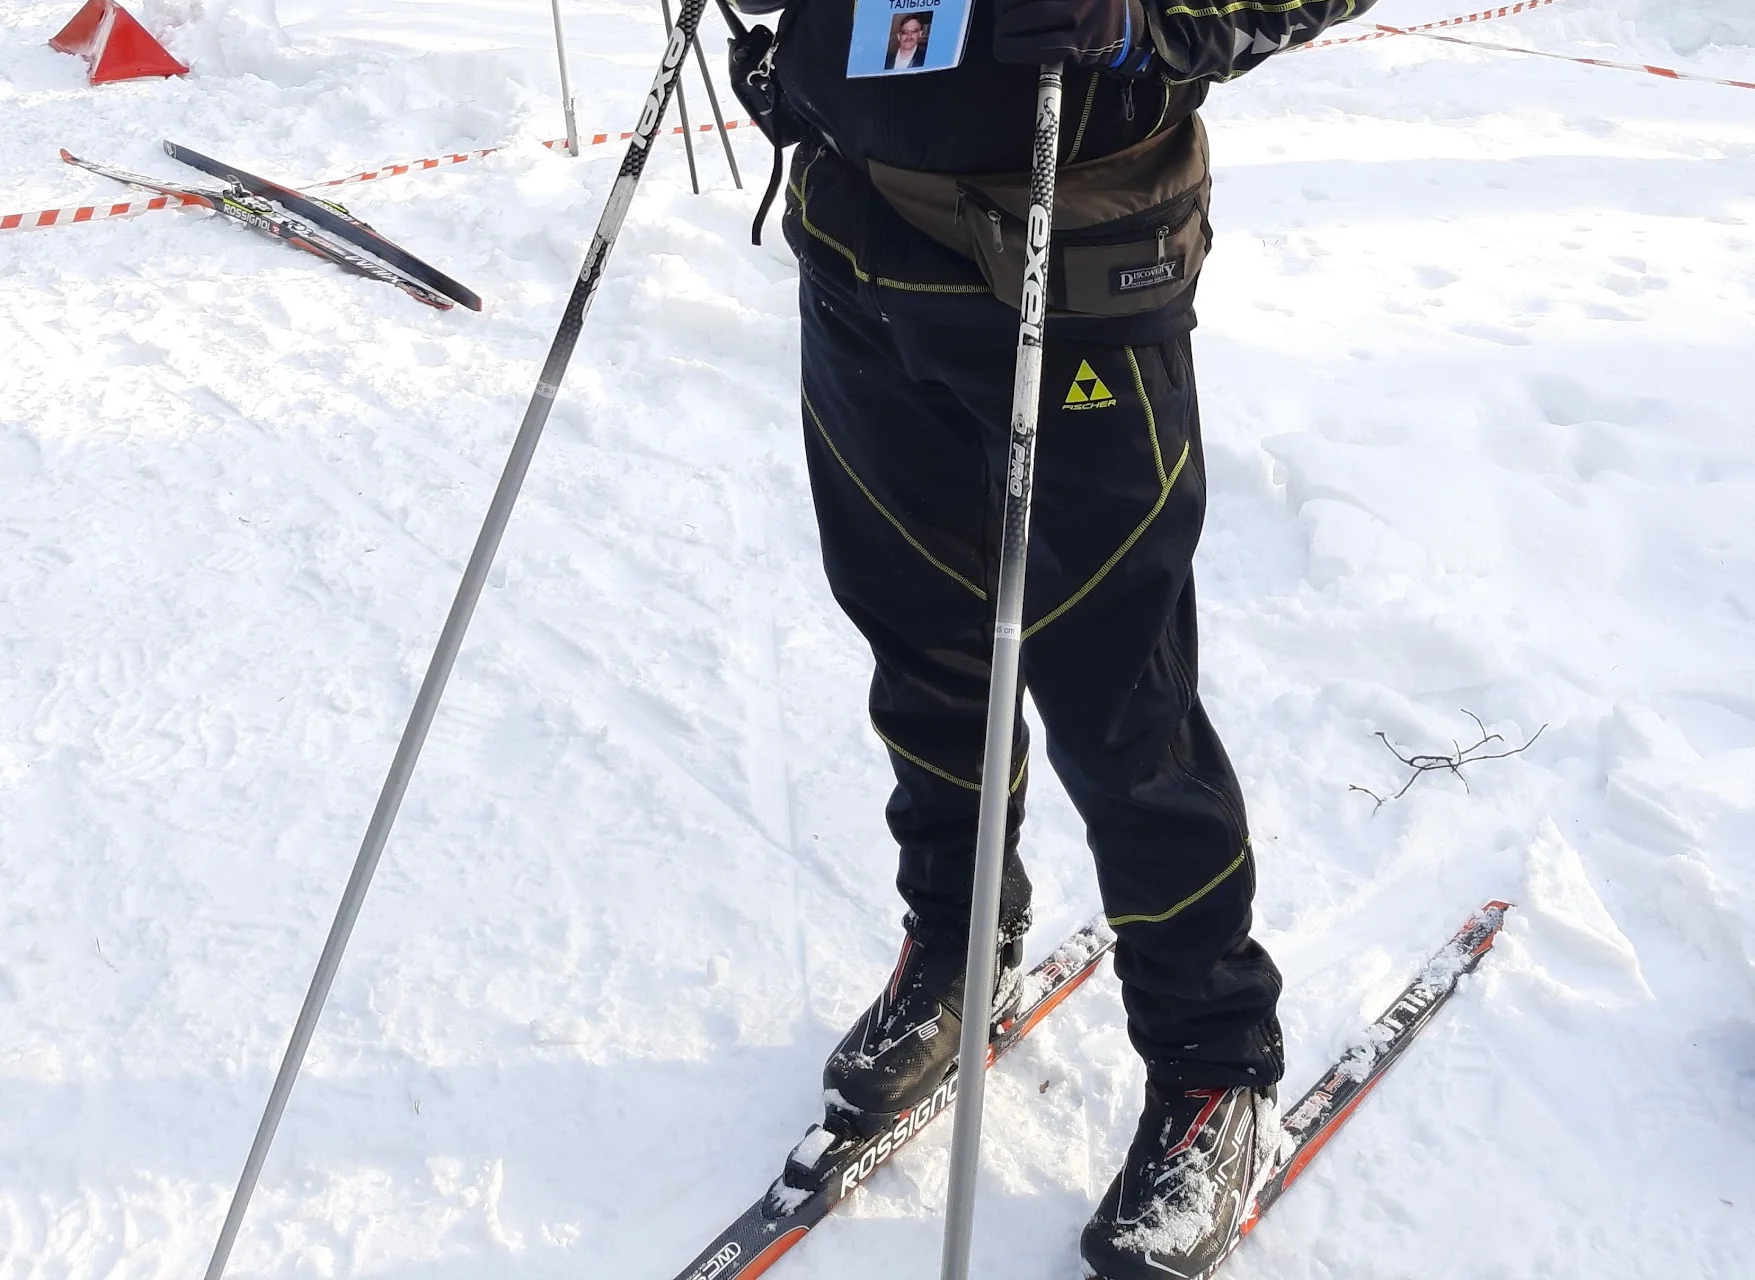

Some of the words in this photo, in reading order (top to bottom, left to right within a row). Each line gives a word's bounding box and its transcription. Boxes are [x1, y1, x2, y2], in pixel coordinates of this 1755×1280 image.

[223, 203, 271, 232] ROSSIGNOL
[1062, 399, 1117, 410] FISCHER
[1010, 441, 1026, 497] PRO
[840, 1072, 959, 1200] ROSSIGNO
